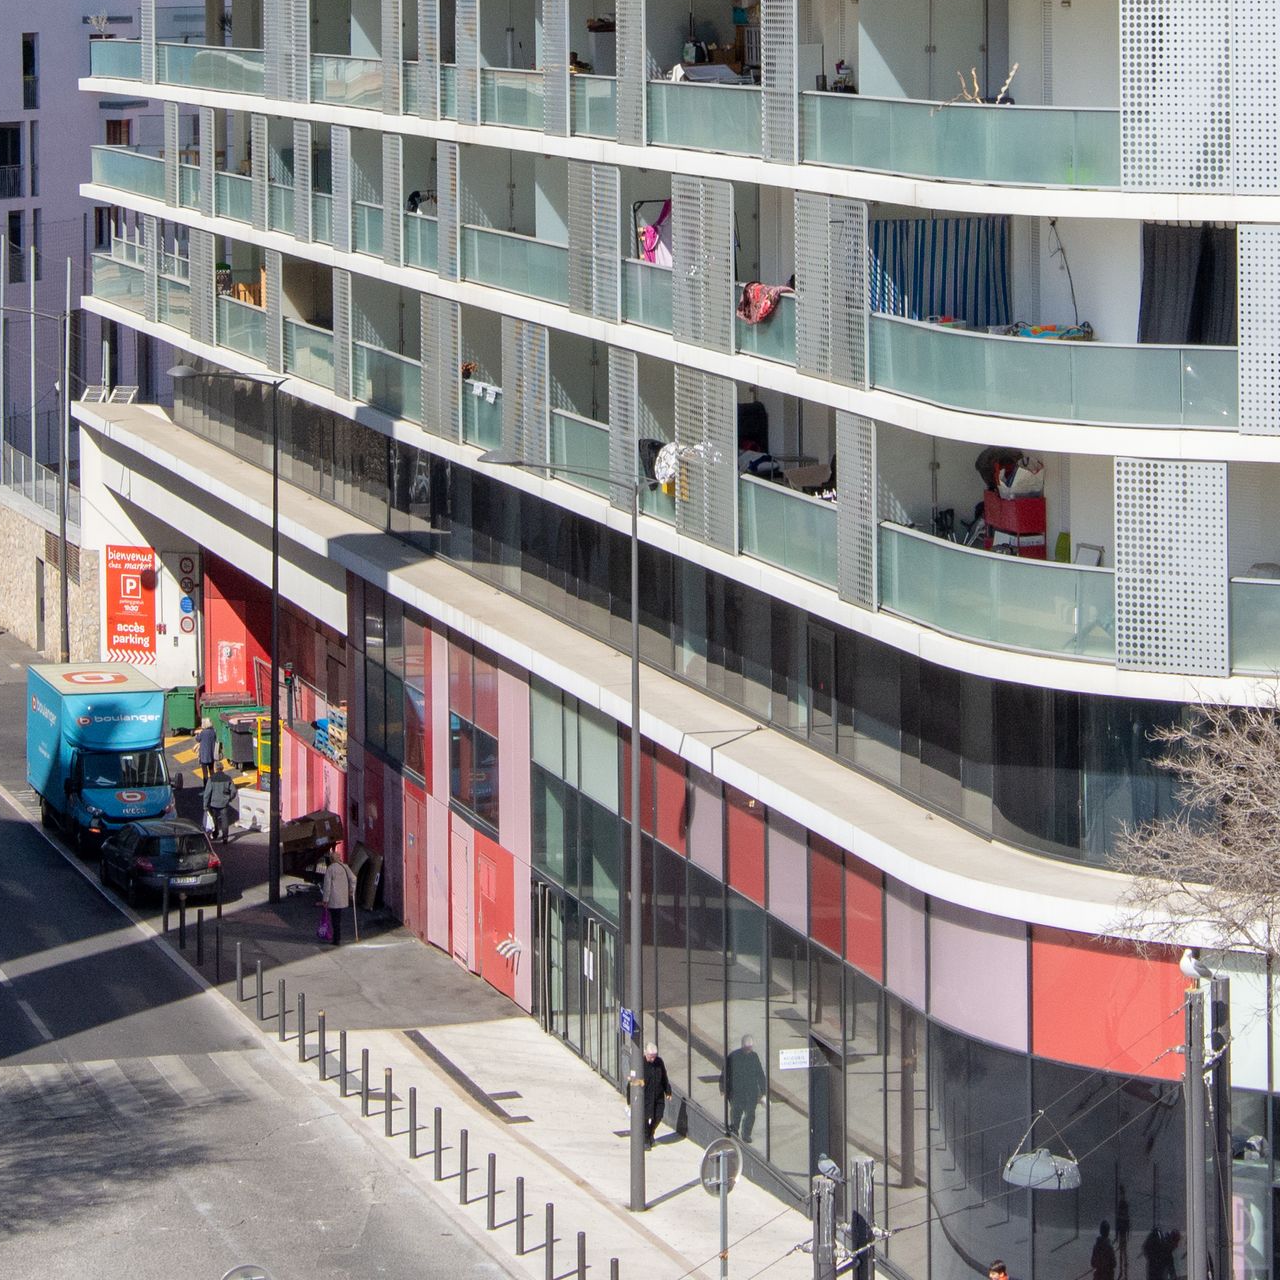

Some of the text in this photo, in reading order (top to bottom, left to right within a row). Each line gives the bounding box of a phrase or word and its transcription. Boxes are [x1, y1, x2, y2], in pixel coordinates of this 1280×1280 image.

[107, 547, 153, 563] bienvenue
[108, 560, 153, 571] chez market
[126, 578, 137, 594] P
[116, 622, 145, 633] accès
[112, 634, 150, 648] parking
[94, 714, 161, 723] boulanger
